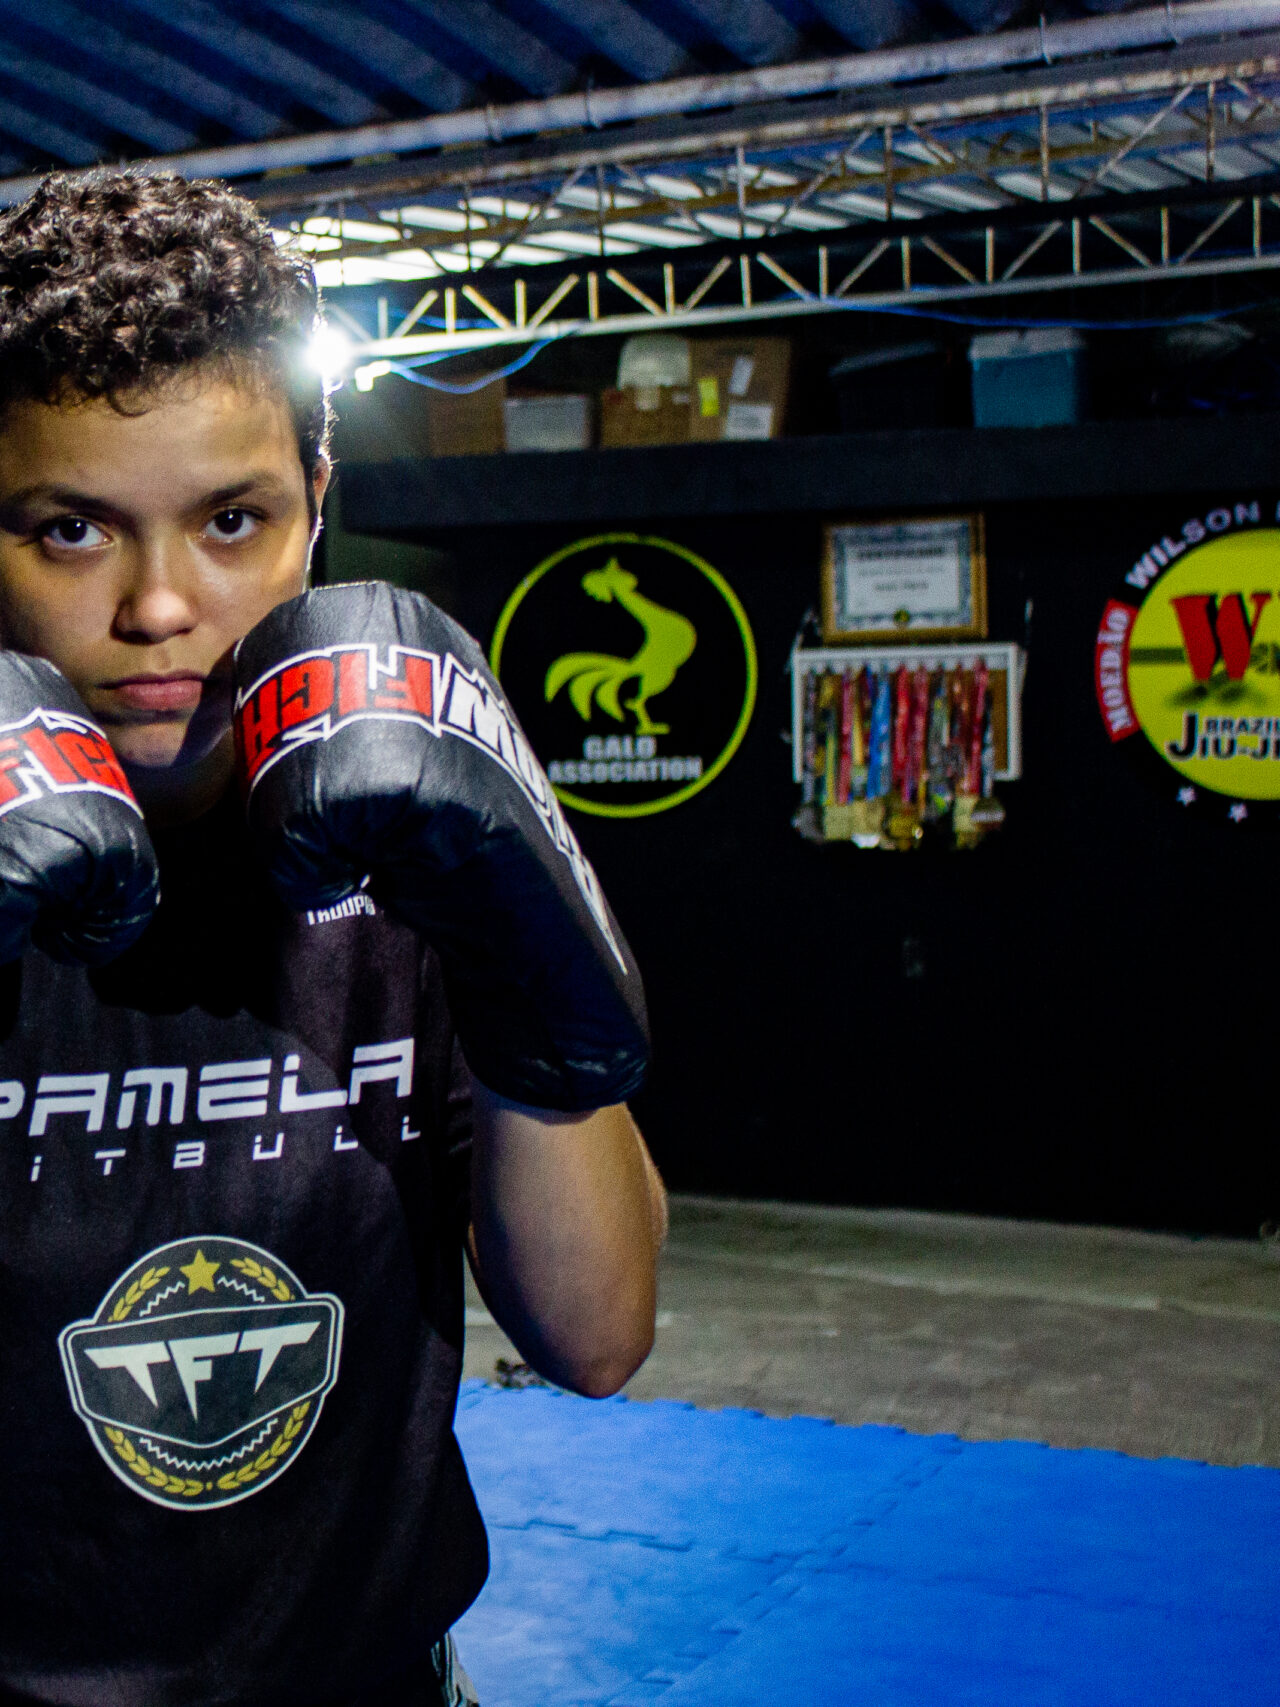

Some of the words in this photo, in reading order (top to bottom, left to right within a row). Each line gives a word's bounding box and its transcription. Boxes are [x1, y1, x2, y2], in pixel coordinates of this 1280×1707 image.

[1125, 500, 1261, 589] WILSON
[236, 650, 435, 783] FIGH
[584, 735, 657, 760] GALO
[547, 756, 703, 784] ASSOCIATION
[83, 1320, 322, 1424] TFT
